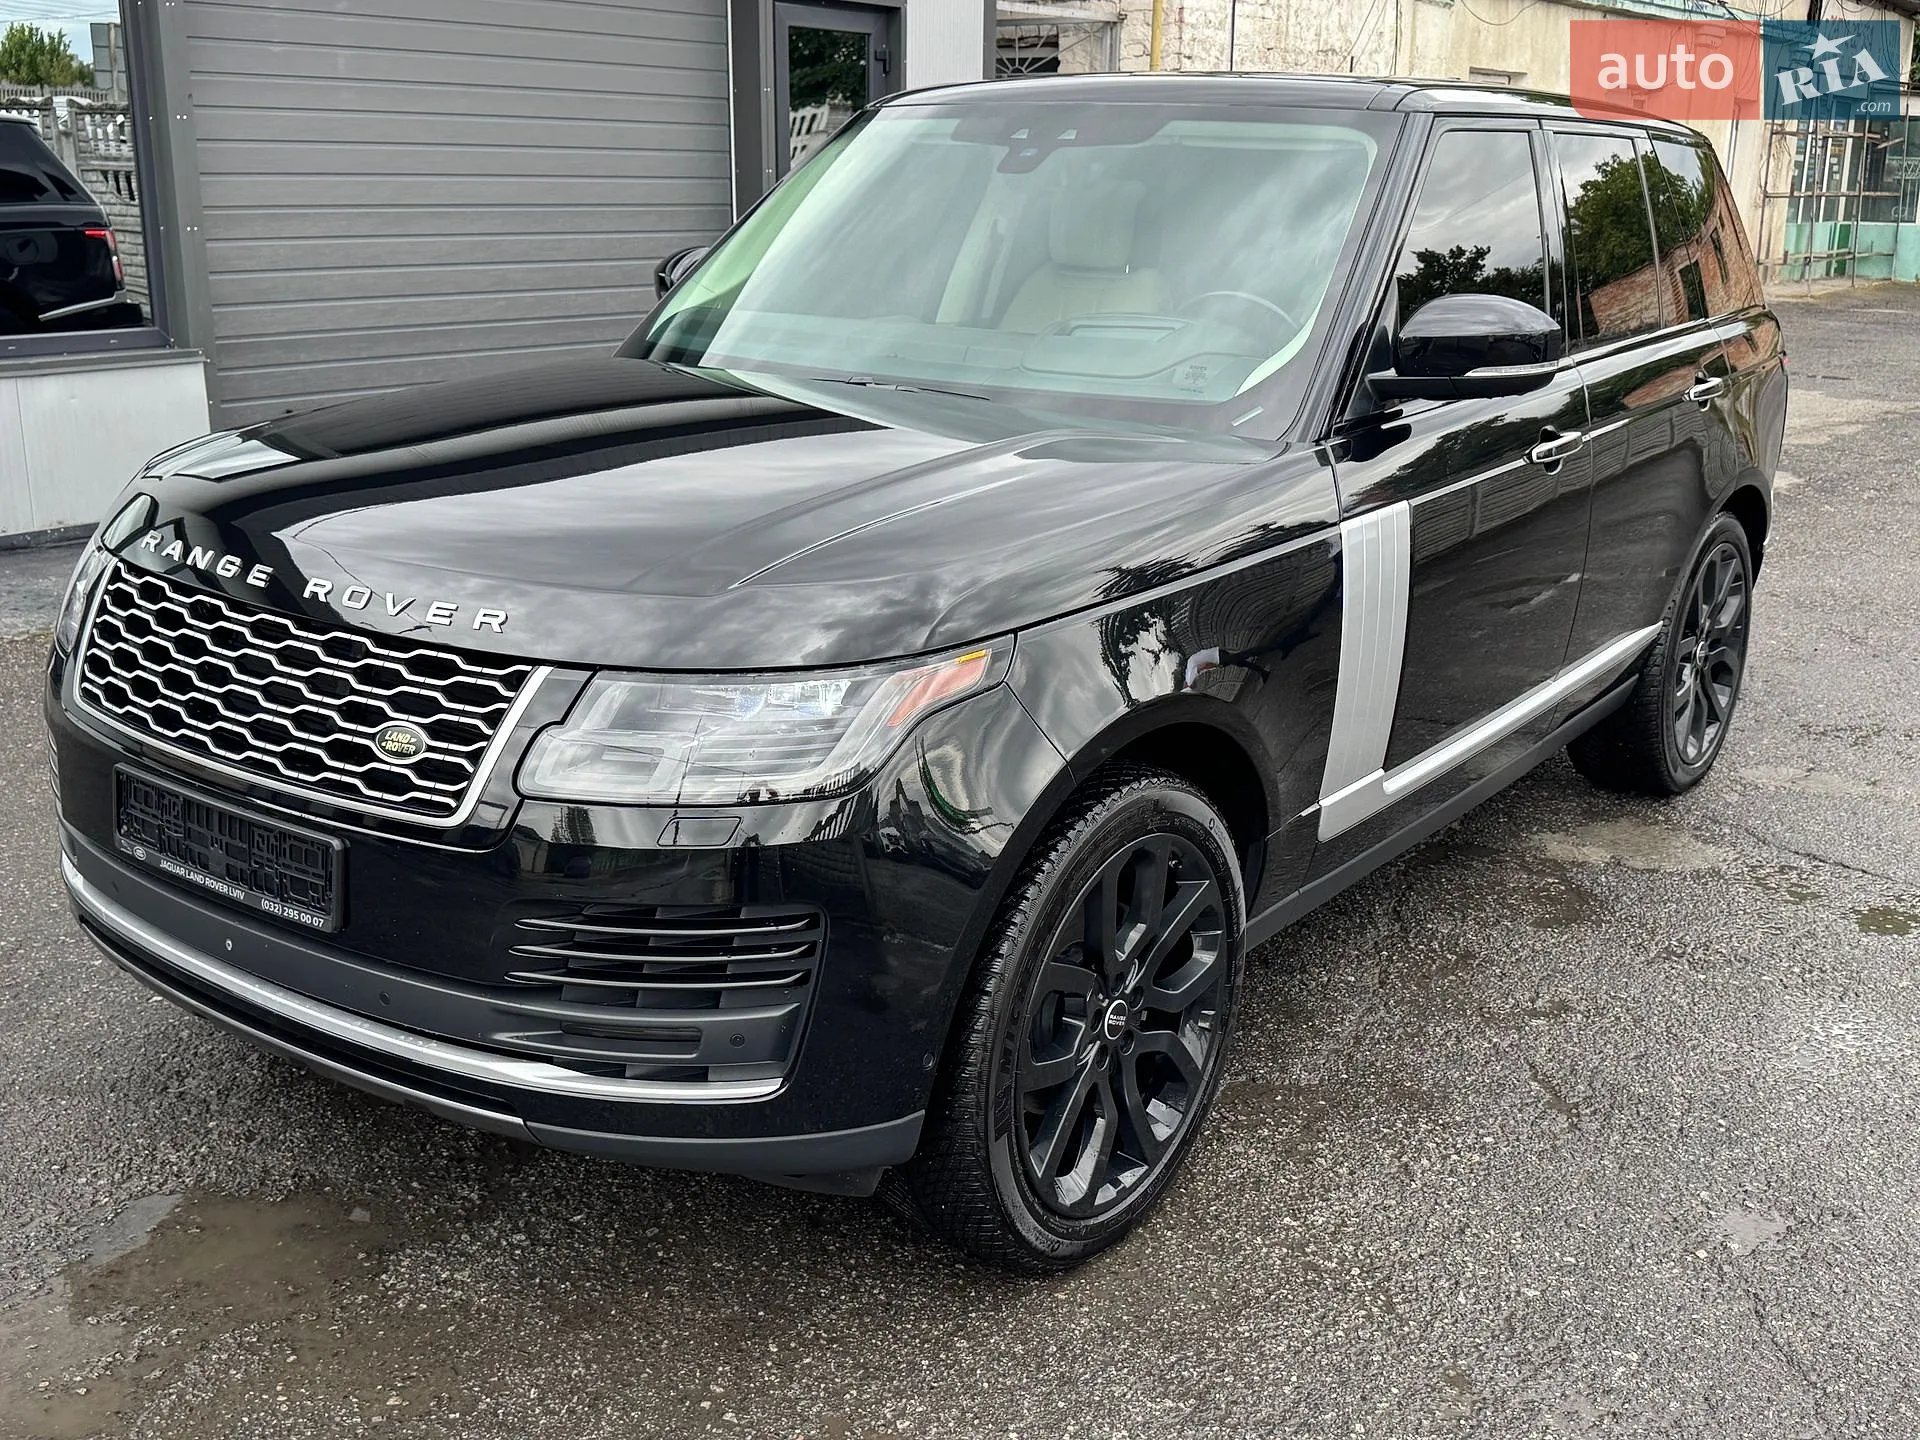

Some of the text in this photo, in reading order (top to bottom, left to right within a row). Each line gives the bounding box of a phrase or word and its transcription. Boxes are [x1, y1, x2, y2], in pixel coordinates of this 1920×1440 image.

[140, 529, 508, 634] RANGE ROVER
[385, 730, 412, 744] LAND
[385, 740, 416, 755] ROVER
[159, 859, 245, 900] JAGUAR LAND ROVER LVIV
[261, 898, 324, 928] (032) 295 00 07
